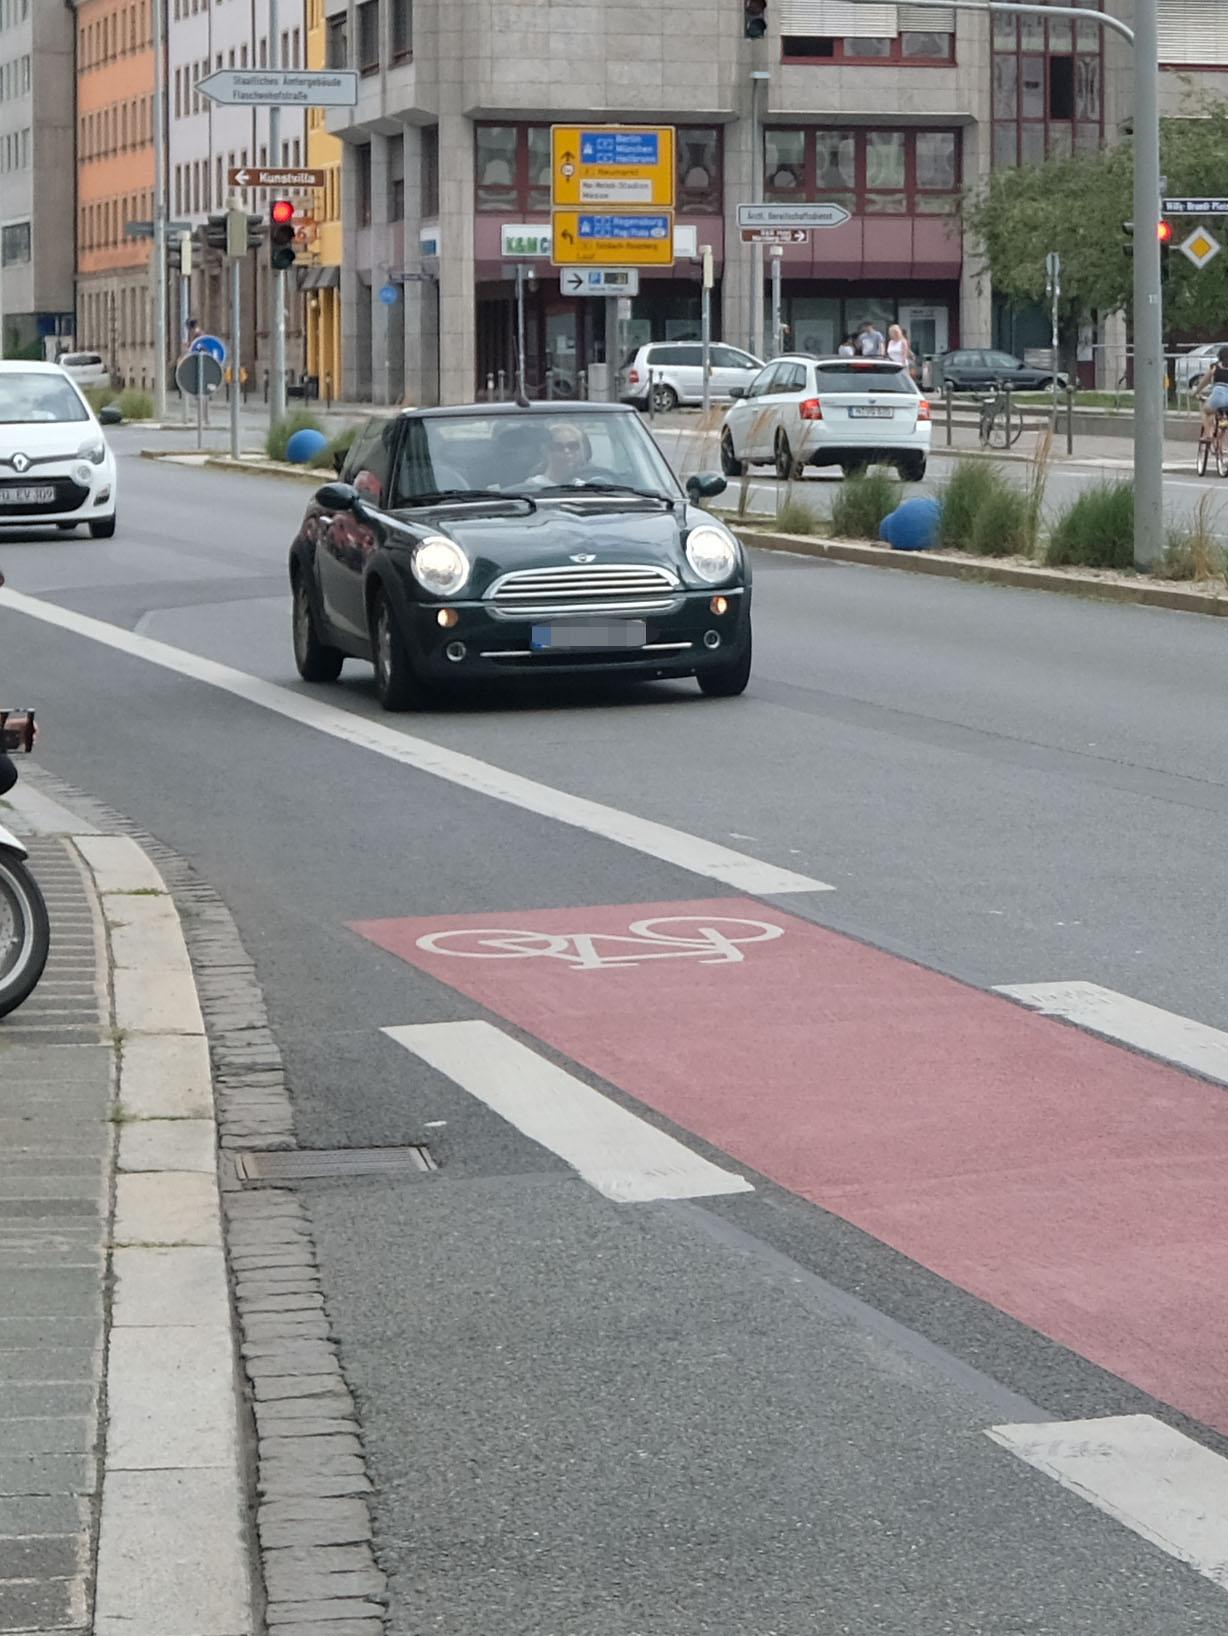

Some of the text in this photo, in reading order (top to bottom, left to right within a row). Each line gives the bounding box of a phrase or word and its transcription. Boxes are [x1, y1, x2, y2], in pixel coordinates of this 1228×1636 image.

[233, 76, 279, 86] Staatliches
[232, 90, 308, 100] Flaschenhofstraße
[615, 134, 642, 143] Berlin
[615, 145, 653, 153] München
[259, 172, 315, 184] Kunstvilla
[505, 236, 538, 252] K&M
